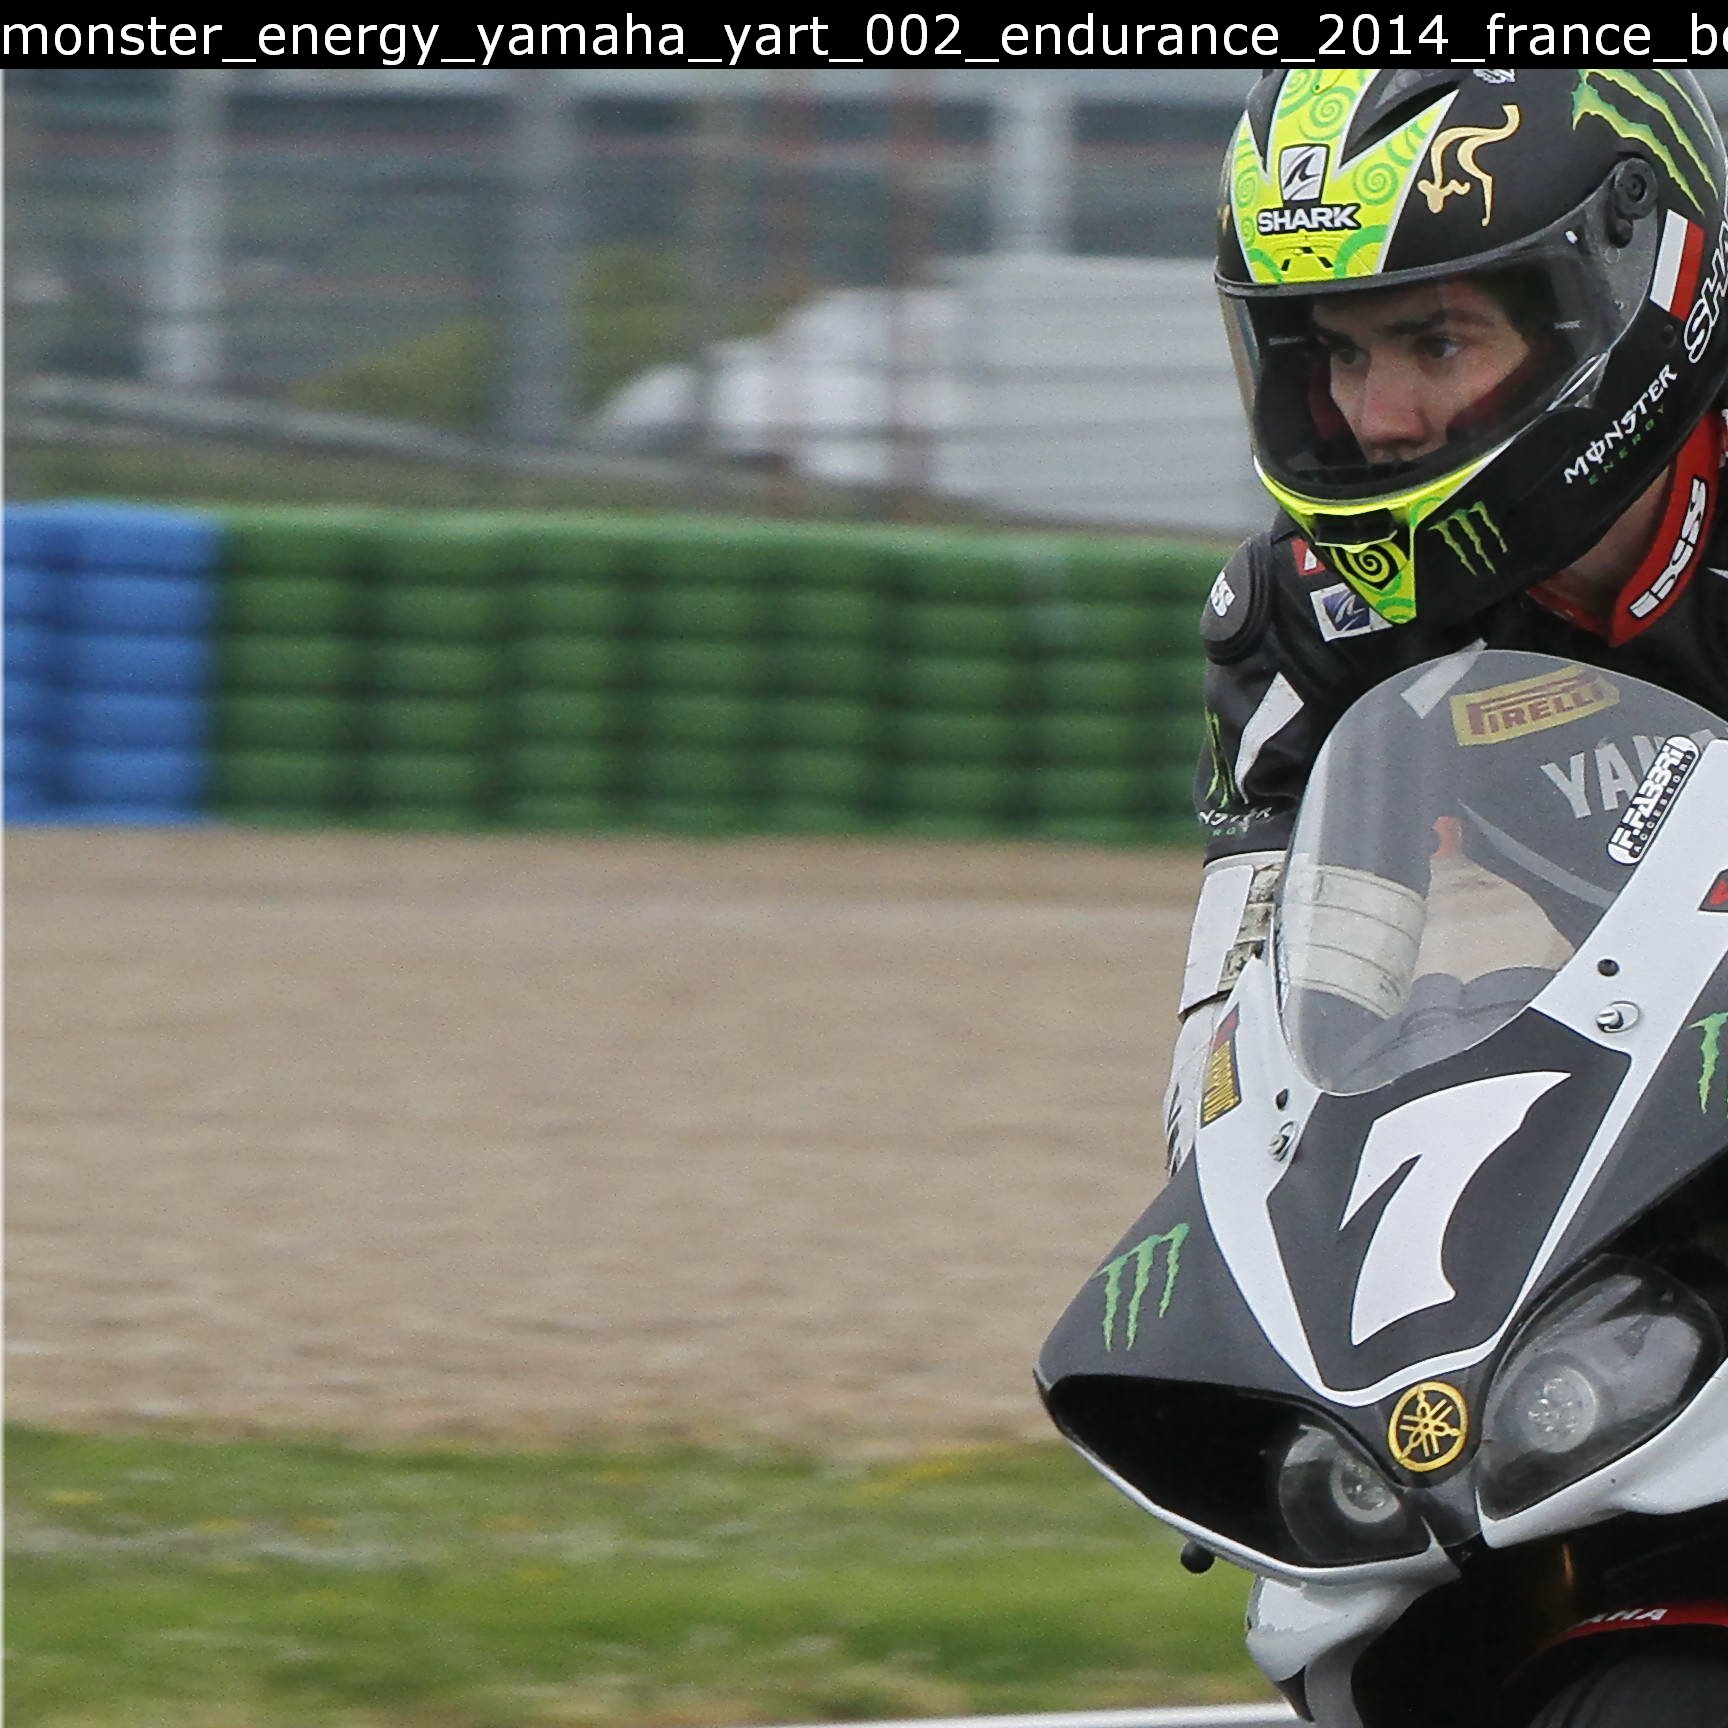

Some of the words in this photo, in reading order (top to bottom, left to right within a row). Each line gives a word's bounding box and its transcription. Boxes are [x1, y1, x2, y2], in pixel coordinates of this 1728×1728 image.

[1257, 205, 1360, 234] SHARK
[1563, 364, 1678, 484] MONSTER
[1466, 672, 1605, 735] PIRELLI
[1338, 1070, 1572, 1346] 7
